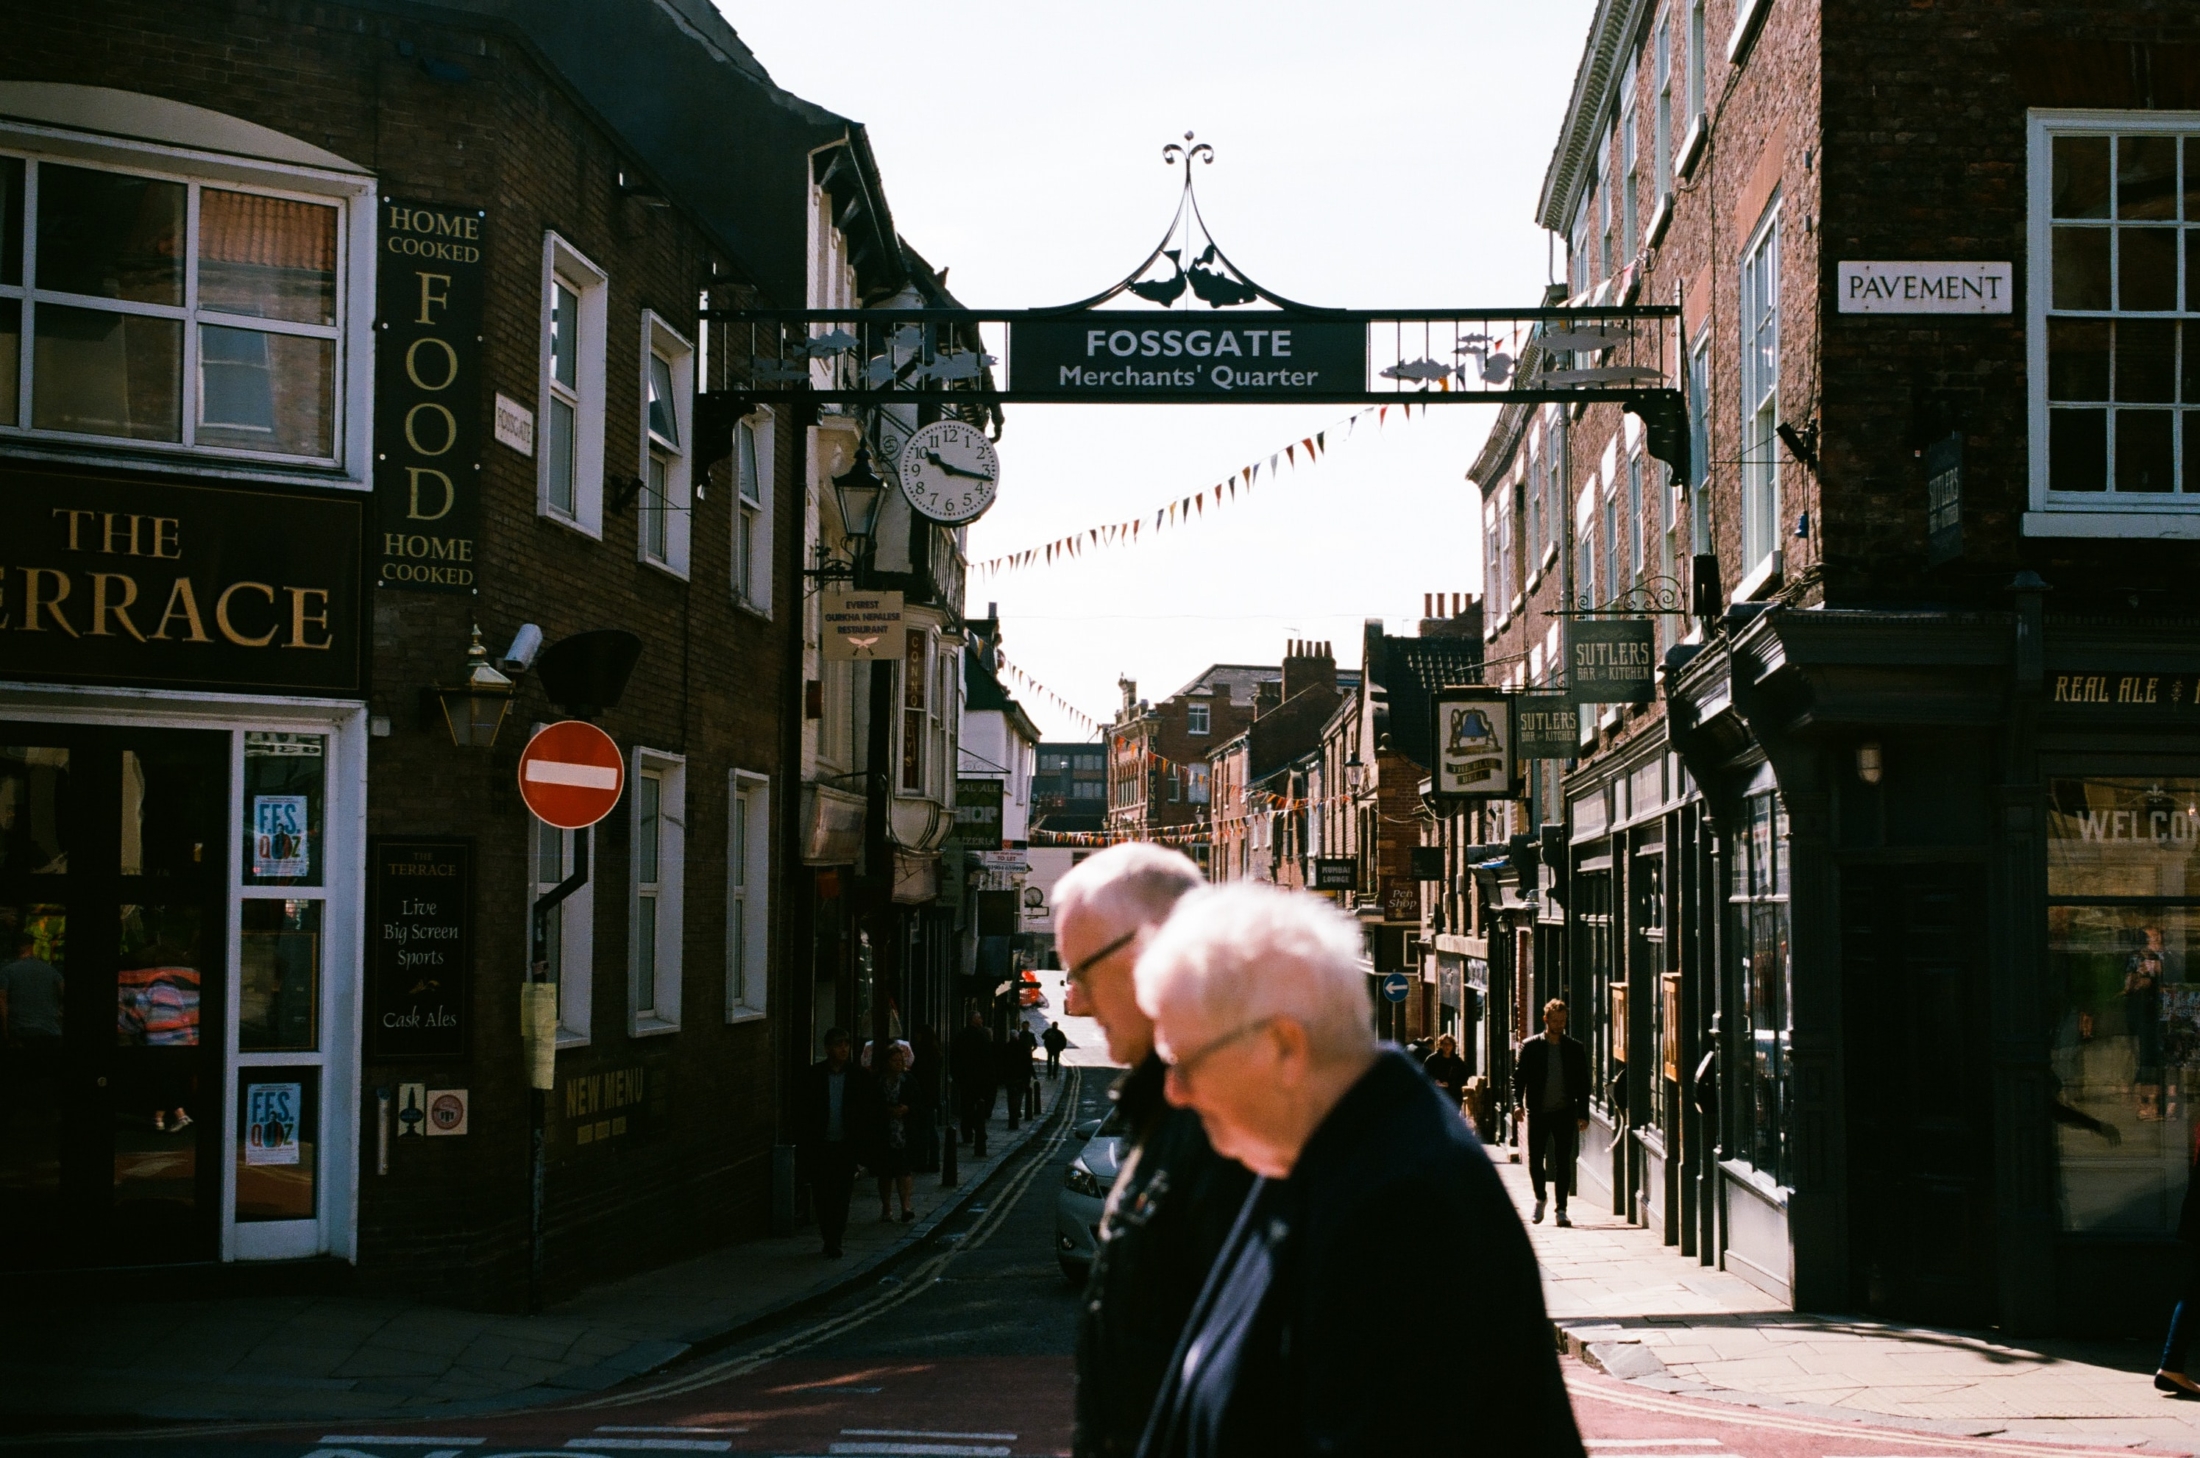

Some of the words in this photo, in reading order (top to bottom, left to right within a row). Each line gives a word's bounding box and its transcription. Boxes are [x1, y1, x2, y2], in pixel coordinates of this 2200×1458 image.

[389, 206, 479, 240] HOME
[388, 236, 480, 264] COOKED
[1850, 276, 2002, 299] PAVEMENT
[1087, 330, 1291, 357] FOSSGATE
[1059, 364, 1202, 386] Merchants'
[1211, 365, 1319, 390] Quarter
[405, 271, 458, 521] FOOD
[929, 435, 939, 448] 11
[943, 429, 958, 443] 12
[965, 435, 970, 448] 1
[915, 446, 928, 459] 10
[976, 446, 986, 459] 2
[911, 464, 921, 477] 9
[982, 464, 991, 476] 3
[915, 482, 925, 494] 8
[974, 482, 984, 494] 4
[930, 493, 939, 506] 7
[945, 498, 955, 512] 6
[962, 493, 972, 506] 5
[53, 508, 182, 560] THE
[383, 533, 473, 562] HOME
[382, 563, 474, 586] COOKED
[0, 565, 333, 650] RRACE
[846, 600, 879, 609] EVEREST
[825, 613, 860, 622] GURKHA
[863, 612, 901, 621] NEPALESE
[837, 625, 888, 634] RESTAURANT
[1576, 642, 1649, 666] SUTLERS
[1577, 667, 1596, 681] BAR
[1609, 666, 1649, 680] KITCHEN
[2054, 676, 2109, 703] REAL
[2117, 677, 2159, 703] ALE
[1520, 712, 1576, 731] SUTLERS
[1521, 731, 1536, 742] BAR
[1545, 730, 1576, 742] KITCHEN
[1451, 765, 1470, 773] THE
[957, 783, 976, 792] EAL
[979, 783, 1000, 793] ALE
[954, 806, 998, 823] HOP
[413, 852, 433, 861] THE
[388, 863, 456, 876] TERRACE
[1321, 866, 1351, 874] MUMBAI
[1323, 876, 1350, 884] LOUNGE
[1392, 889, 1413, 898] Pen
[402, 898, 437, 916] Live
[1388, 899, 1417, 910] Shop
[383, 922, 408, 945] Big
[411, 923, 459, 940] Screen
[397, 949, 444, 970] Sports
[383, 1005, 421, 1028] Cask
[425, 1005, 457, 1027] Ales
[566, 1074, 600, 1119] NEW
[604, 1066, 643, 1110] MENU
